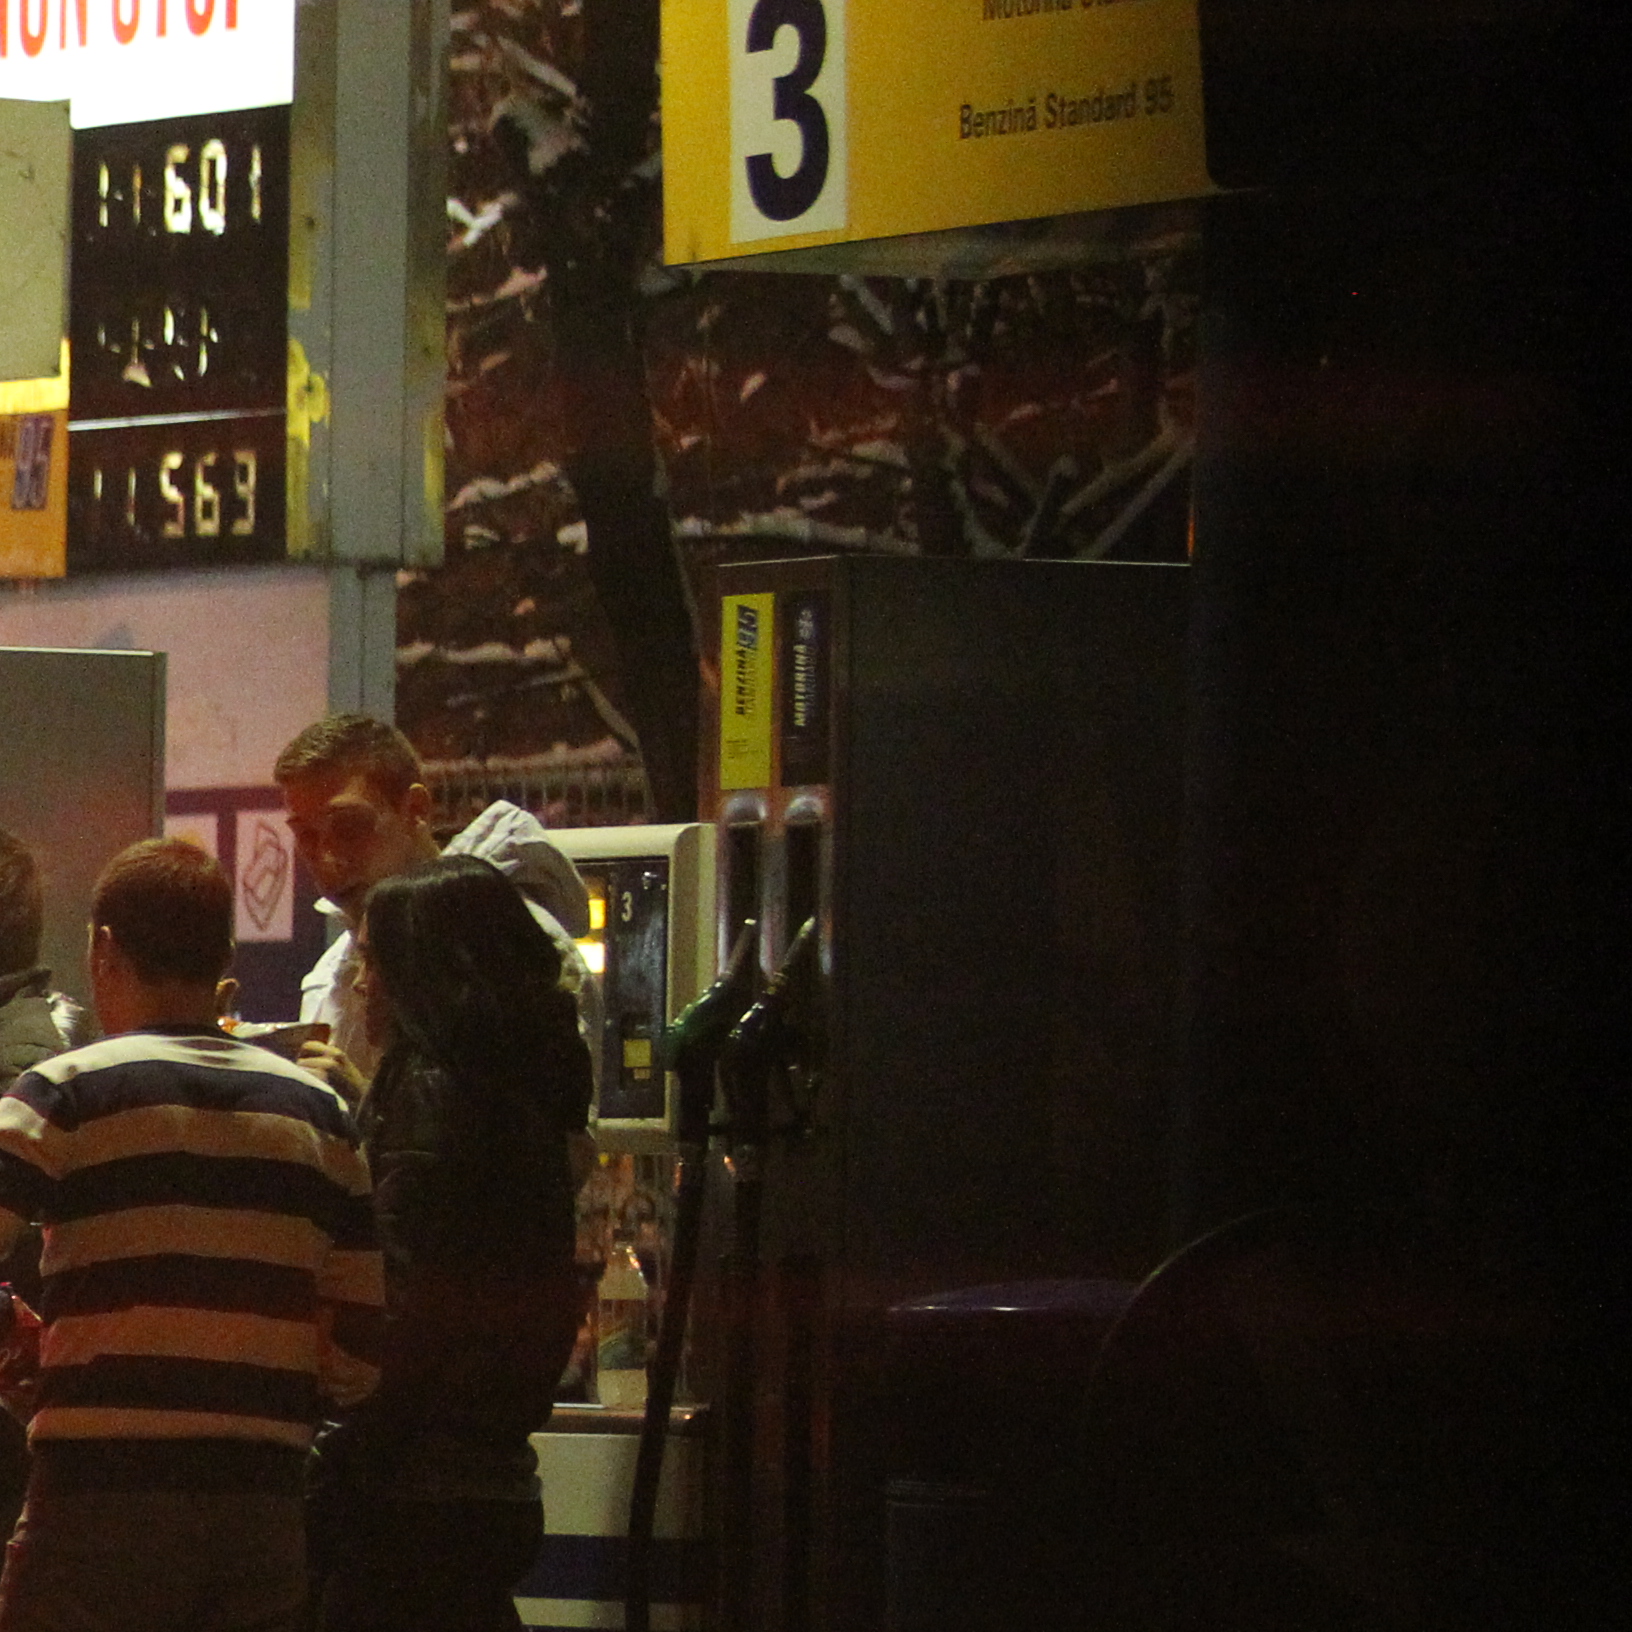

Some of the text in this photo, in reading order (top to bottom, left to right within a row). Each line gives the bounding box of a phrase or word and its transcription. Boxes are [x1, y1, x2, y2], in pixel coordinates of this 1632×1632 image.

[745, 0, 830, 221] 3
[1045, 81, 1137, 129] Standard
[1143, 75, 1173, 115] 95
[621, 891, 633, 922] 3
